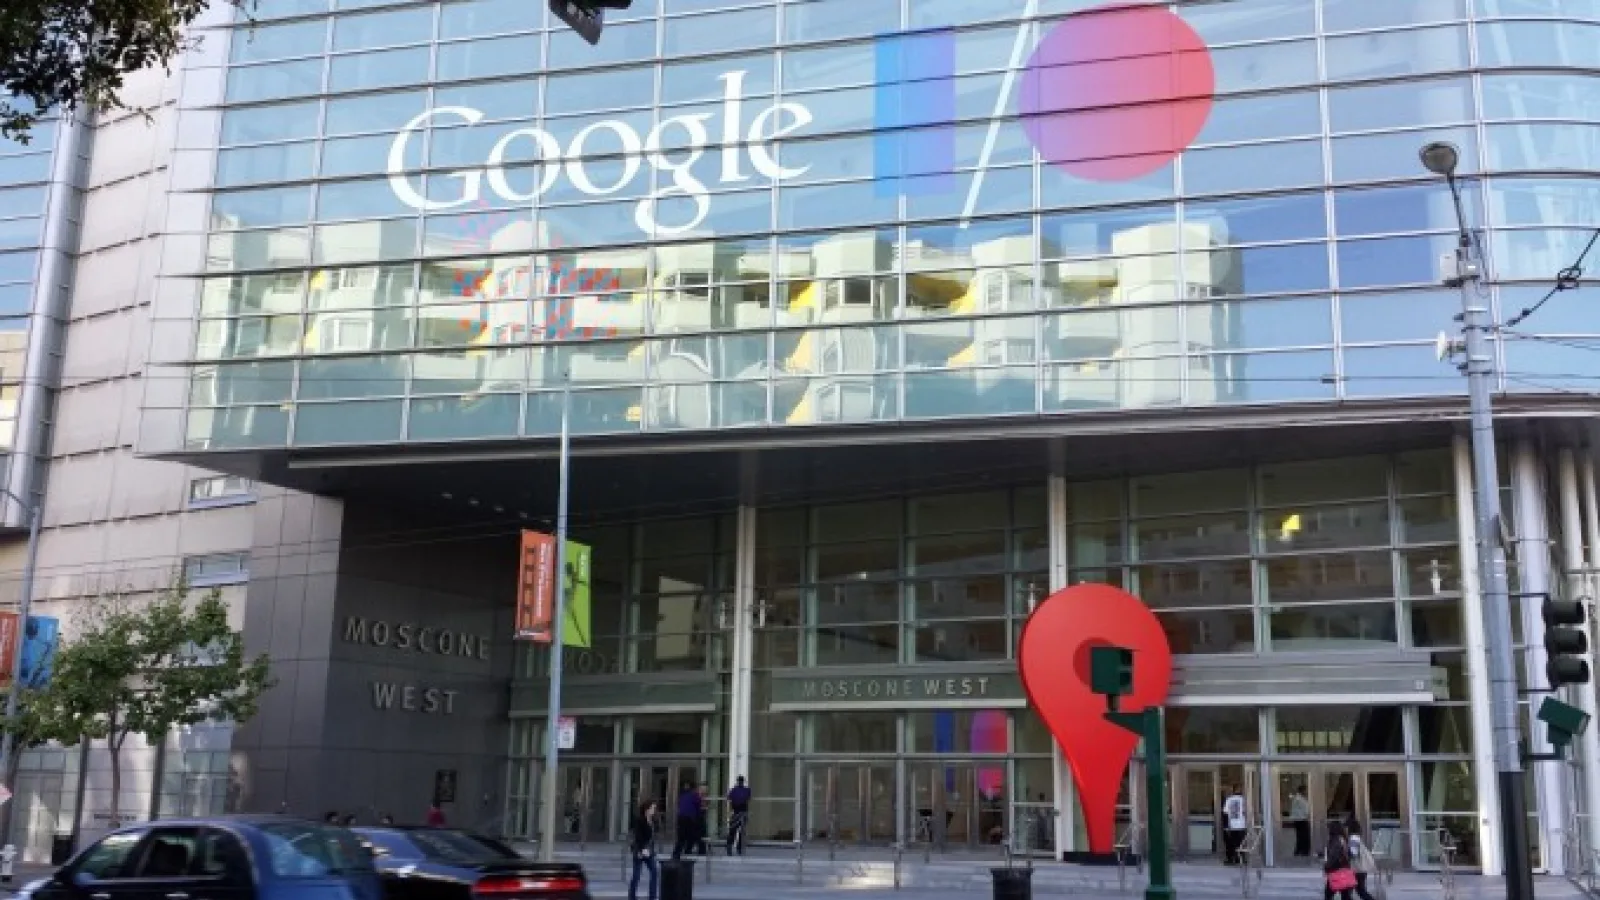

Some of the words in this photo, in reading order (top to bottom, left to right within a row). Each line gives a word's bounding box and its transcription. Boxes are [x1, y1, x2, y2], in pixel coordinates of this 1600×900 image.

[388, 70, 812, 235] Google
[344, 615, 490, 660] MOSCONE
[373, 681, 459, 714] WEST
[803, 678, 914, 697] MOSCONE
[924, 676, 989, 695] WEST
